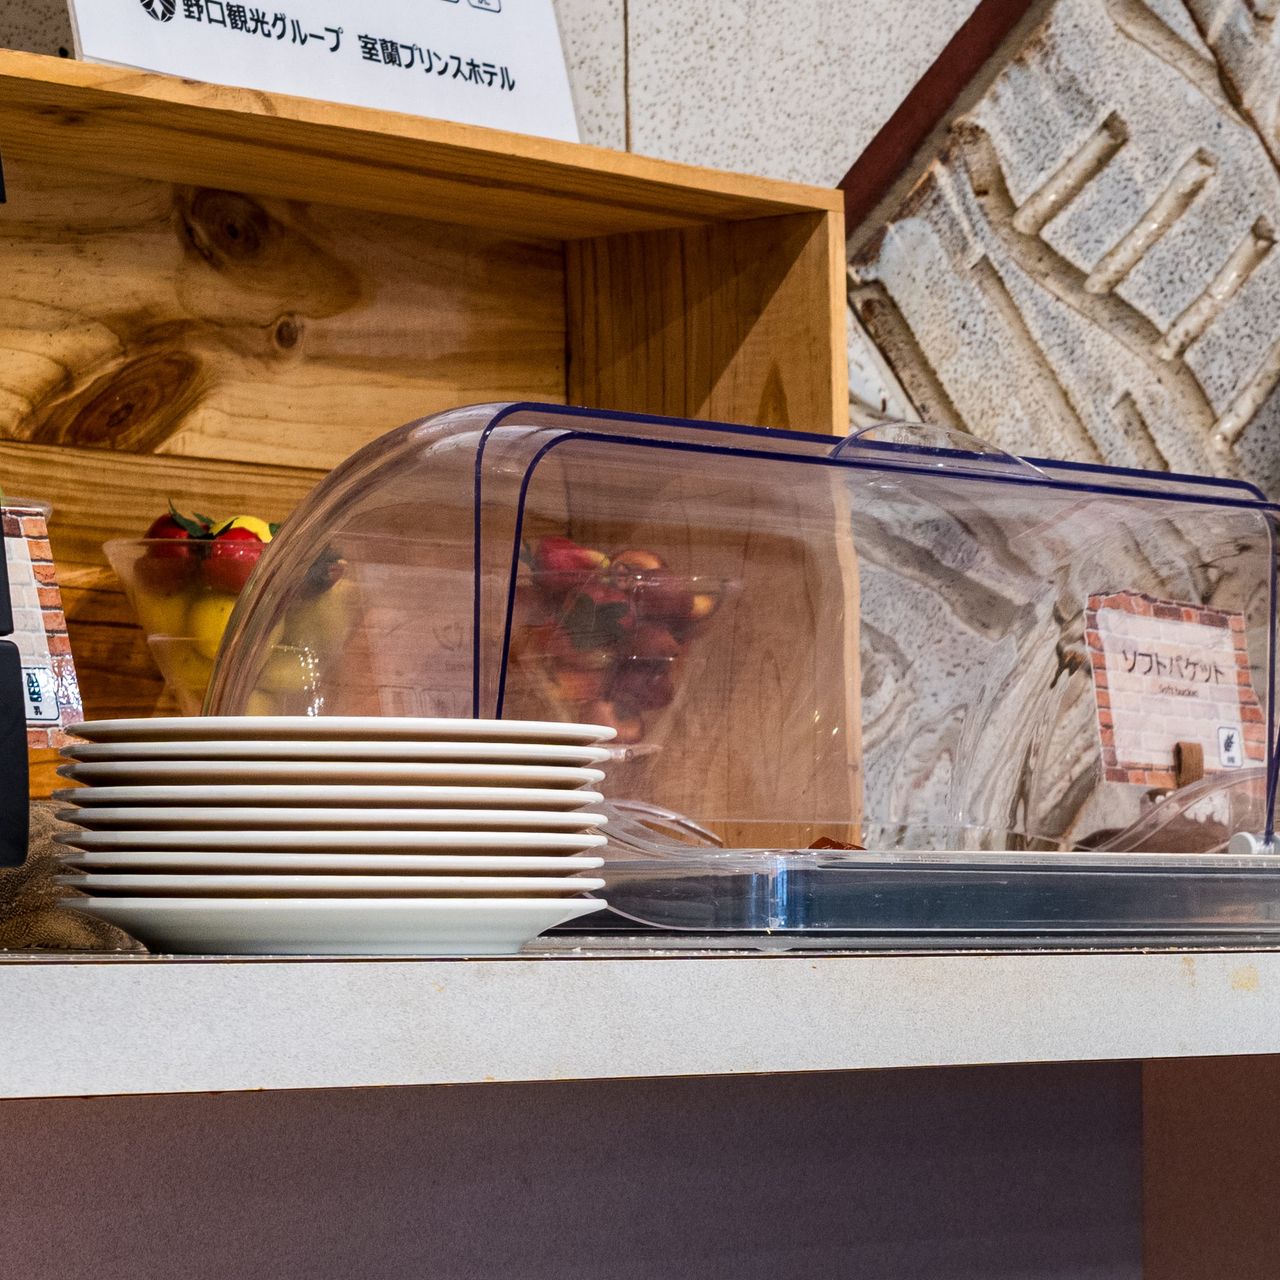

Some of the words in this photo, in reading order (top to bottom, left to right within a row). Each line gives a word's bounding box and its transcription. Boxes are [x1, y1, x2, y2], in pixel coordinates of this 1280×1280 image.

[183, 0, 344, 52] 野口観光グループ
[358, 34, 516, 92] 室蘭プリンスホテル
